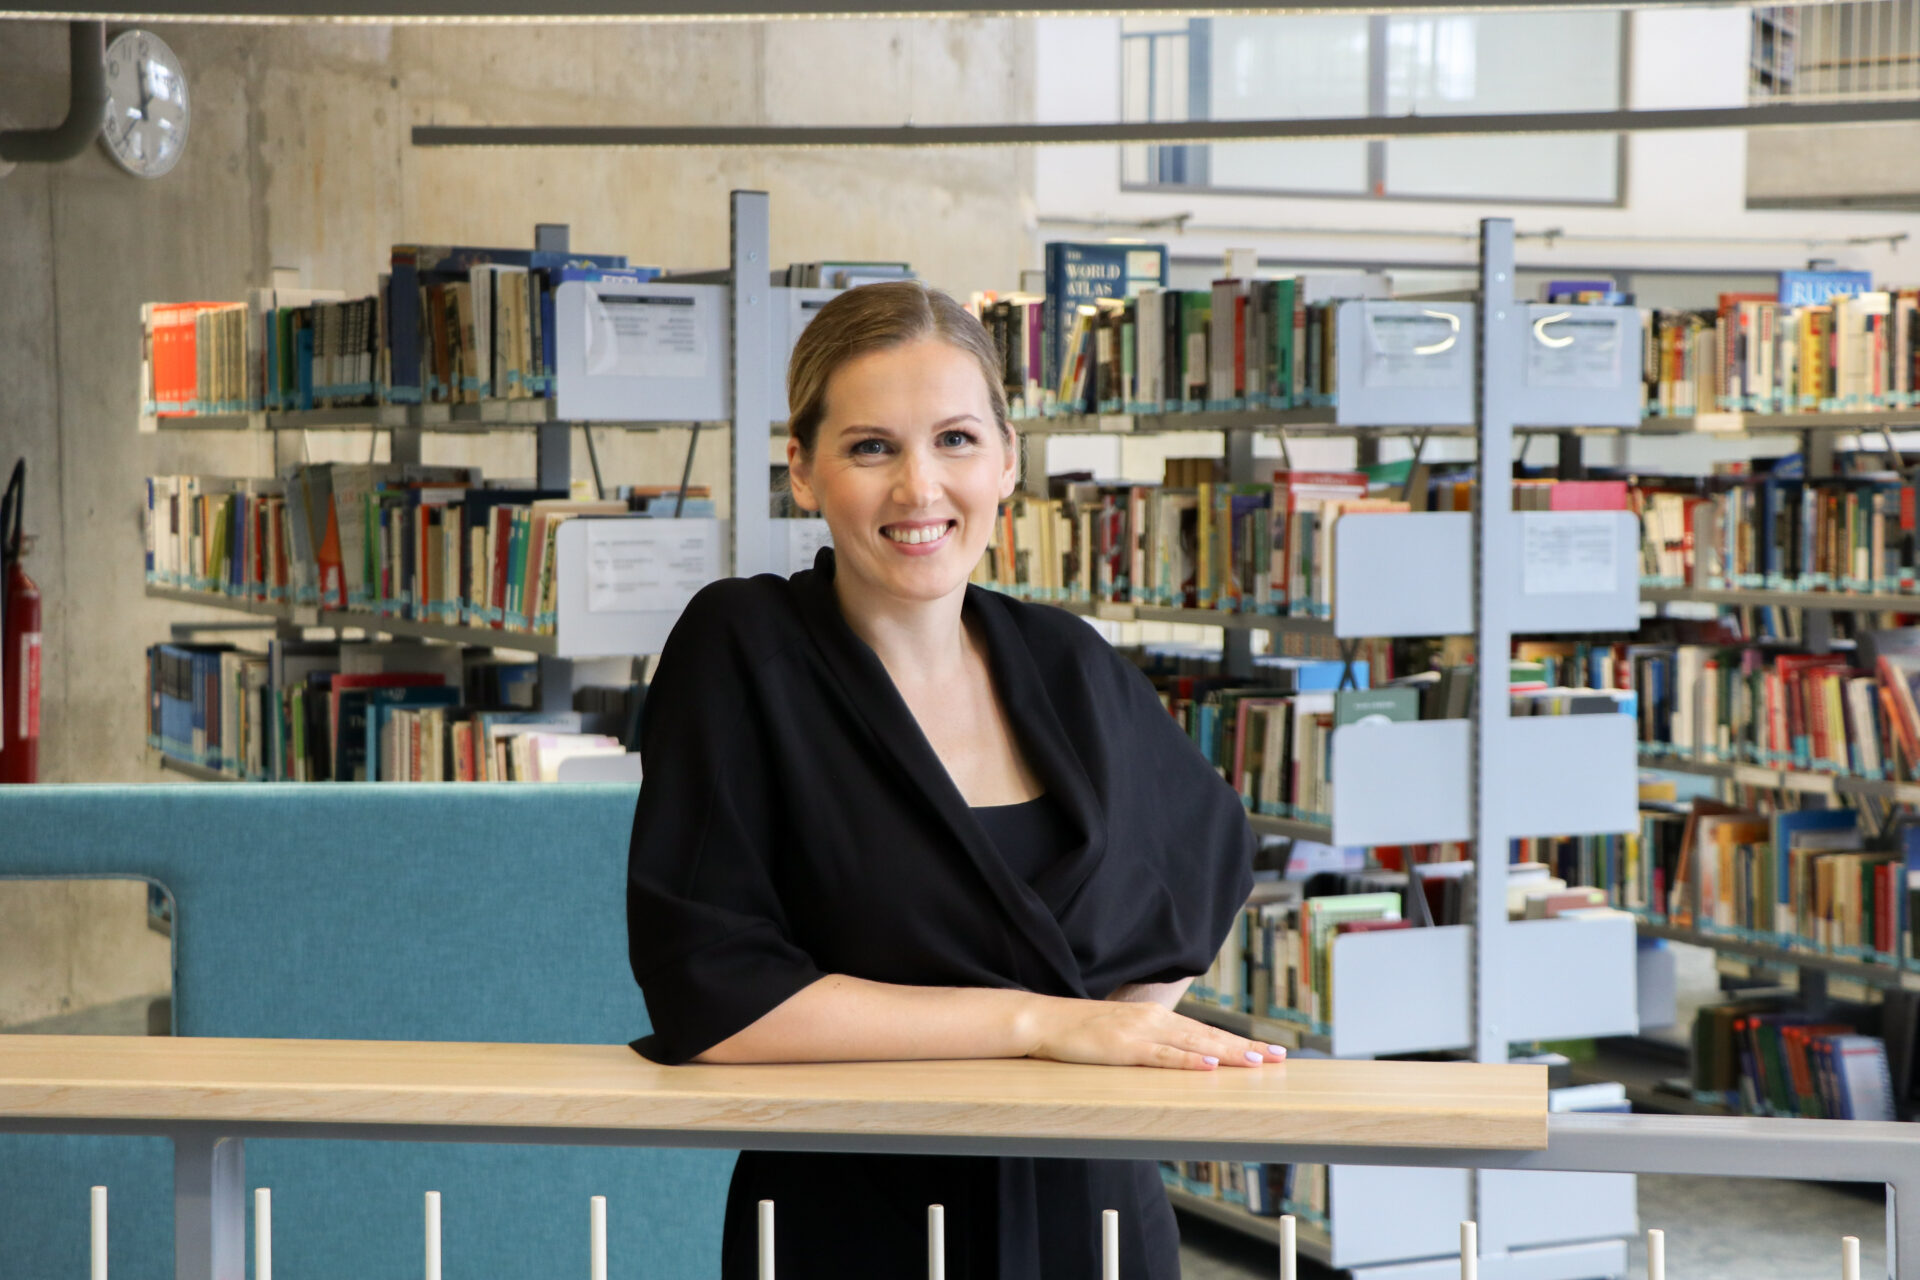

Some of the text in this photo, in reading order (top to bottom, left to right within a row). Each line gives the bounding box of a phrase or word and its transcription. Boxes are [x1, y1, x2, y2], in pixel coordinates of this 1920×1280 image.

[1064, 263, 1121, 280] WORLD
[1065, 280, 1113, 297] ATLAS
[1791, 281, 1867, 305] RUSSIA
